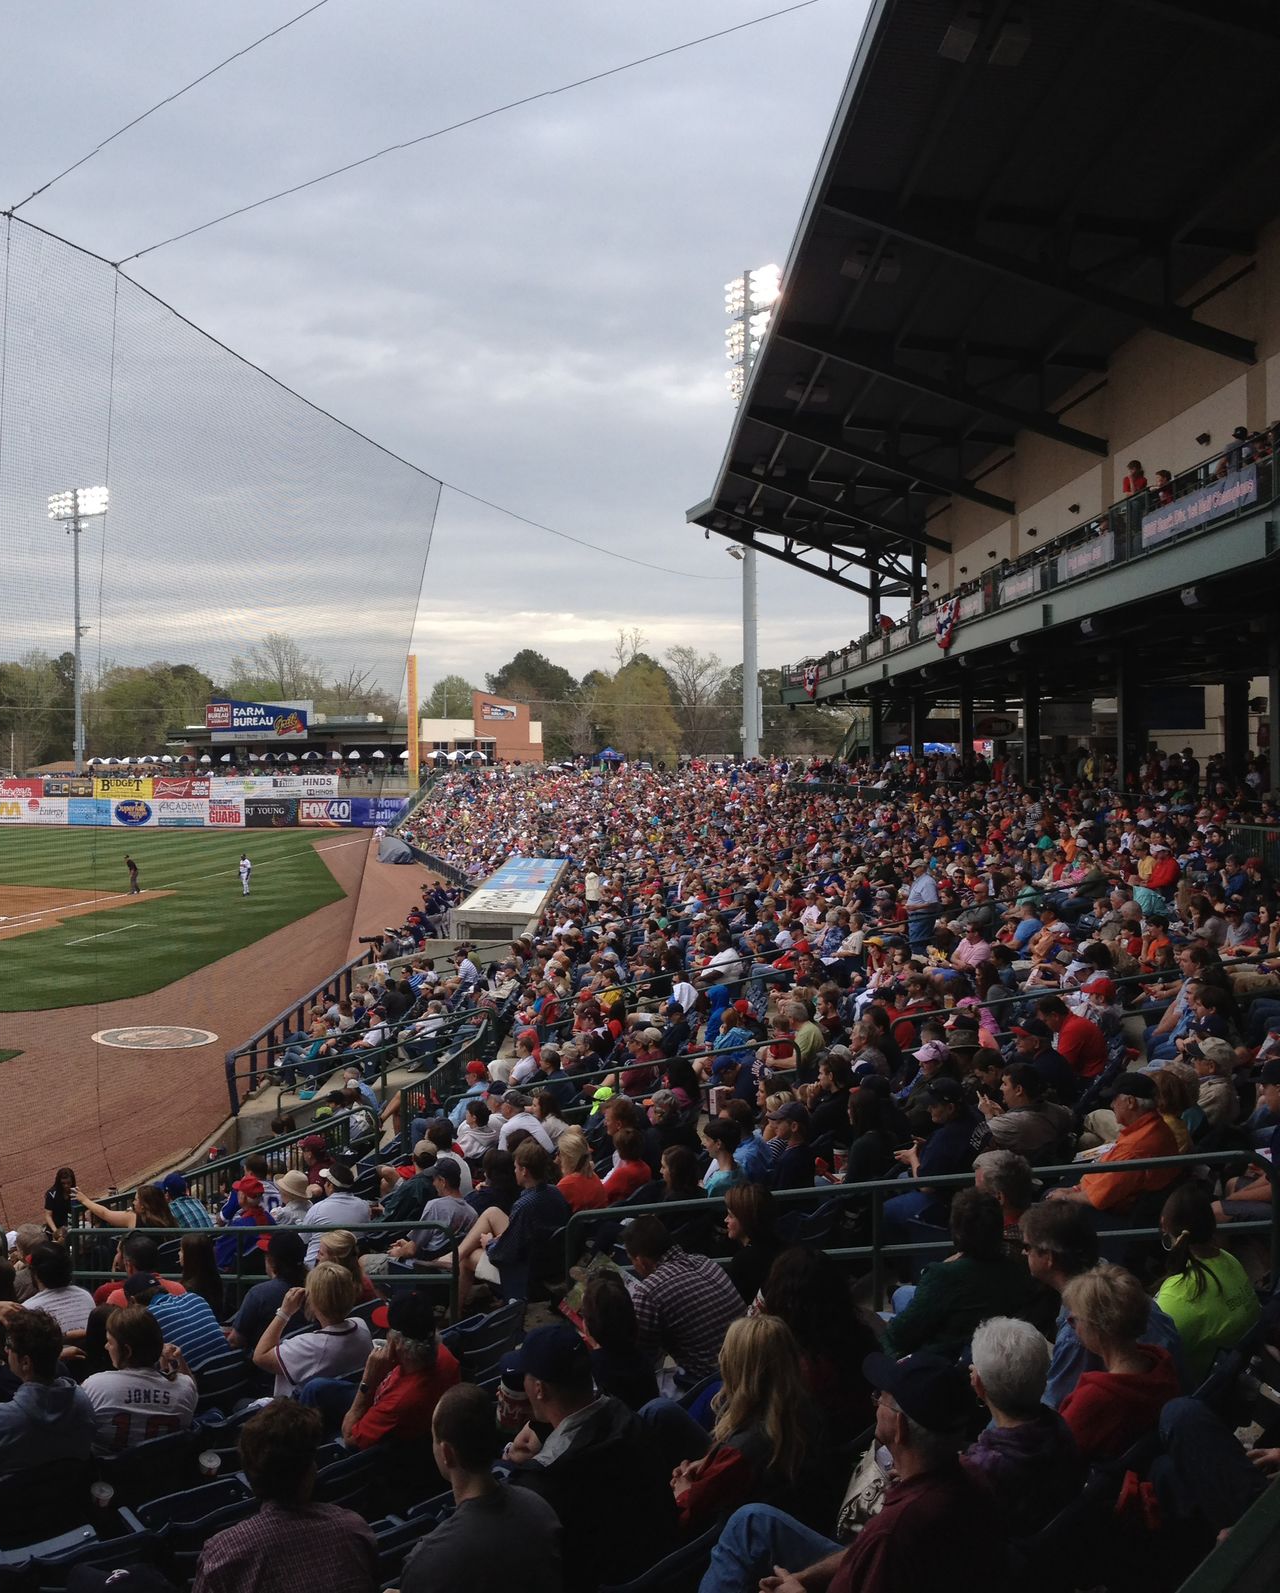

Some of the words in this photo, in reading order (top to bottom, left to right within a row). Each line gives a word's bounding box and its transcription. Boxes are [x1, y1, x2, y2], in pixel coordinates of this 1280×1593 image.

[233, 707, 265, 716] FARM
[233, 717, 274, 726] BUREAU
[100, 780, 143, 791] BUDGET
[160, 802, 204, 811] ACADEMY
[302, 802, 327, 818] FOX
[329, 802, 349, 818] 40
[209, 811, 240, 823] GUARD
[369, 809, 398, 819] Earlie
[124, 1388, 171, 1405] JONES
